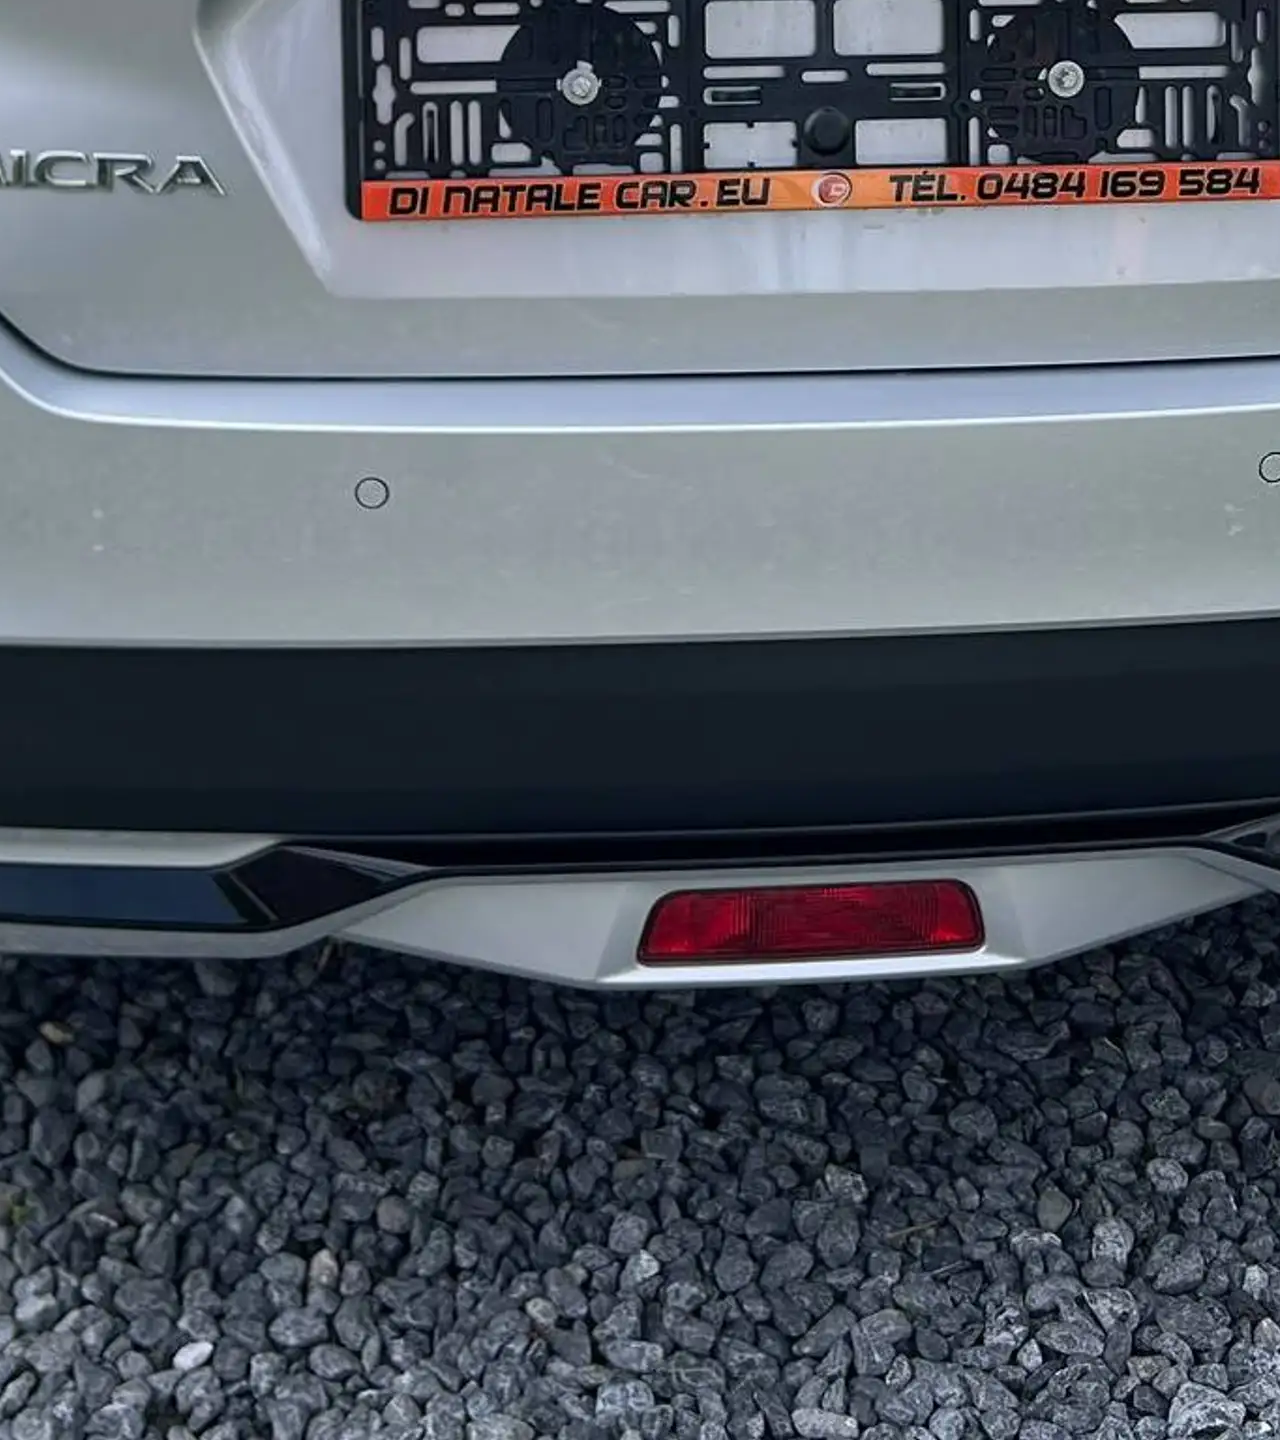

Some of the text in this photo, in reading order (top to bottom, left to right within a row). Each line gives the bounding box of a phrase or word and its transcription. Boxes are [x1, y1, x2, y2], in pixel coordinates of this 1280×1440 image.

[389, 186, 431, 215] DI
[443, 183, 602, 215] NATALE
[889, 167, 1260, 202] TÉL. 0484 169 584
